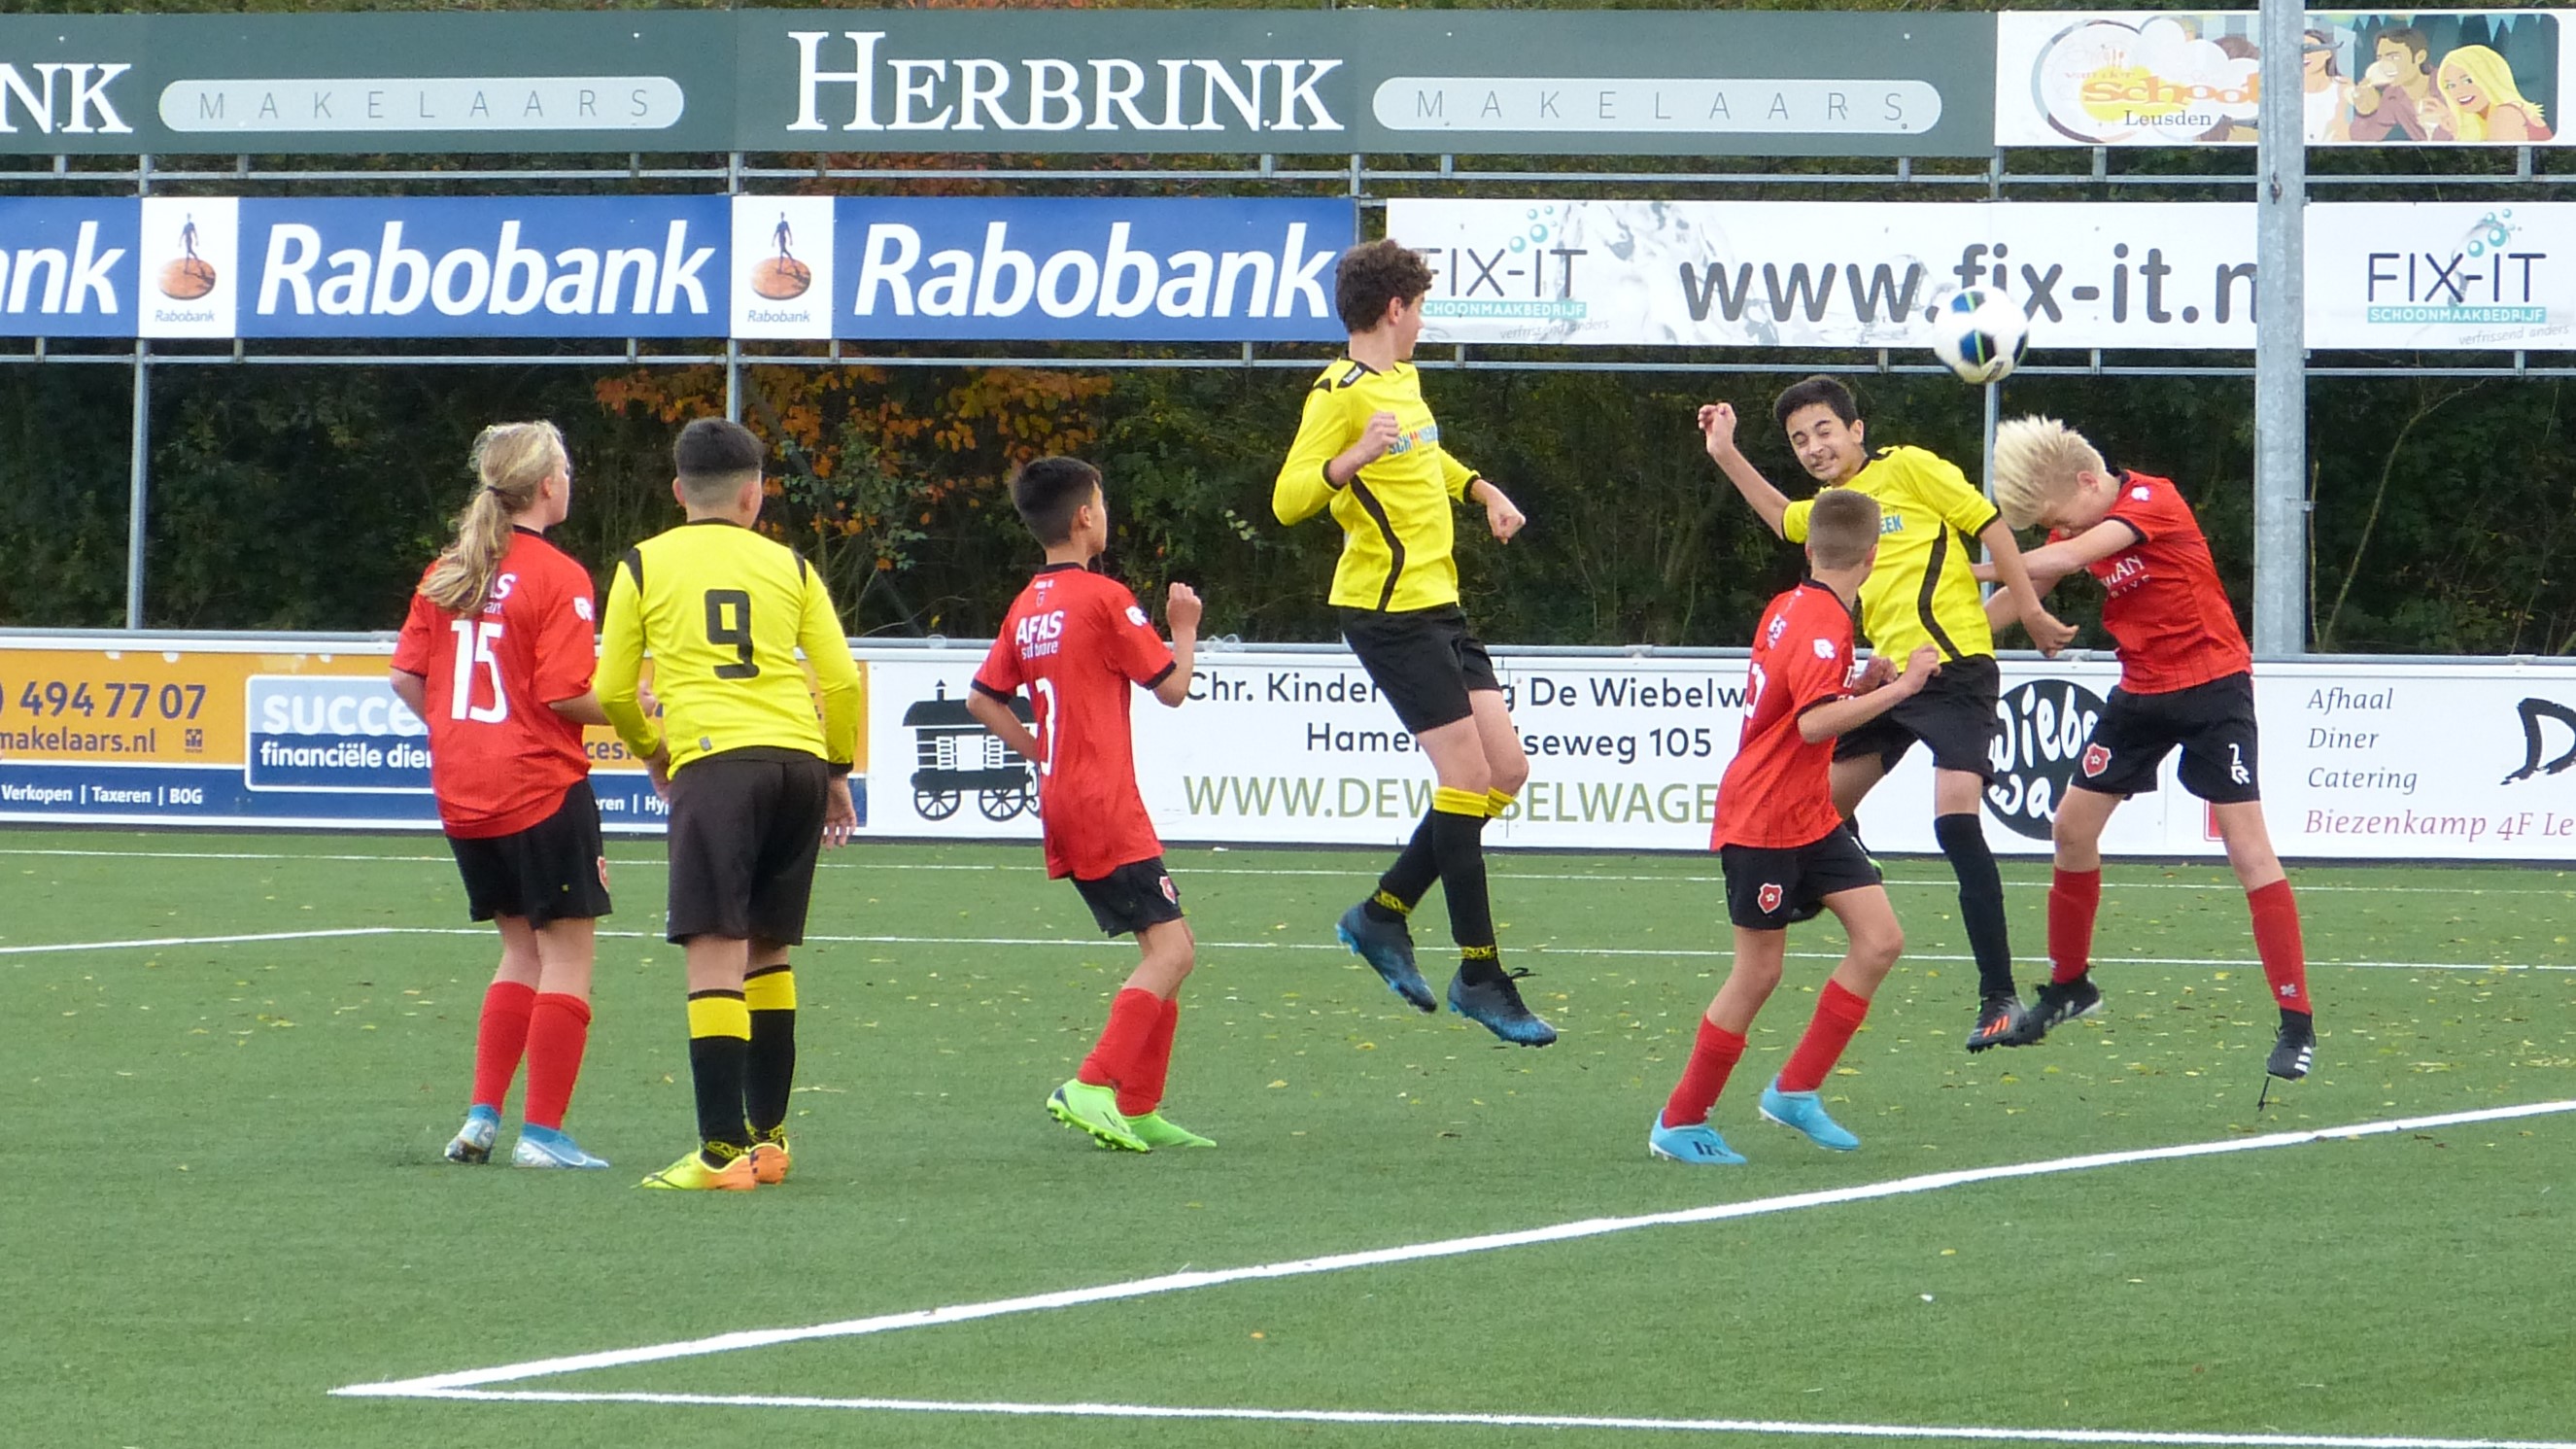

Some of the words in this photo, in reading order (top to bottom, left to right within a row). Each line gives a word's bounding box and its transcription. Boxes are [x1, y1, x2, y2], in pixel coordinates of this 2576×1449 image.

[786, 30, 1345, 131] HERBRINK
[199, 89, 648, 120] MAKELAARS
[1417, 89, 1904, 121] MAKELAARS
[2125, 109, 2213, 126] Leusden
[256, 220, 716, 316] Rabobank
[853, 221, 1337, 319] Rabobank
[2367, 253, 2547, 303] FIX-IT
[154, 308, 217, 323] Rabobank
[746, 309, 811, 324] Rabobank
[1423, 301, 1584, 317] CHOONMAAKBEDRIJF
[2370, 308, 2544, 322] SCHOONMAAKBEDRIJF
[2459, 328, 2524, 345] verfrissend
[2529, 325, 2570, 338] anders
[704, 589, 760, 679] 9
[1015, 610, 1064, 645] AFAS
[451, 619, 508, 723] 15
[19, 680, 94, 717] 494
[105, 683, 151, 718] 77
[159, 684, 206, 720] 07
[1186, 672, 1254, 702] Chr.
[1530, 677, 1577, 707] De
[2307, 687, 2393, 715] Afhaal
[1649, 728, 1712, 757] 105
[2307, 727, 2380, 749] Diner
[260, 741, 382, 769] financiële
[1, 784, 73, 805] Verkopen
[91, 786, 152, 804] Taxeren
[169, 788, 203, 805] BOG
[2308, 766, 2418, 795] Catering
[2304, 809, 2488, 843] Biezenkamp
[2496, 811, 2534, 841] 4F
[2542, 812, 2574, 836] Le
